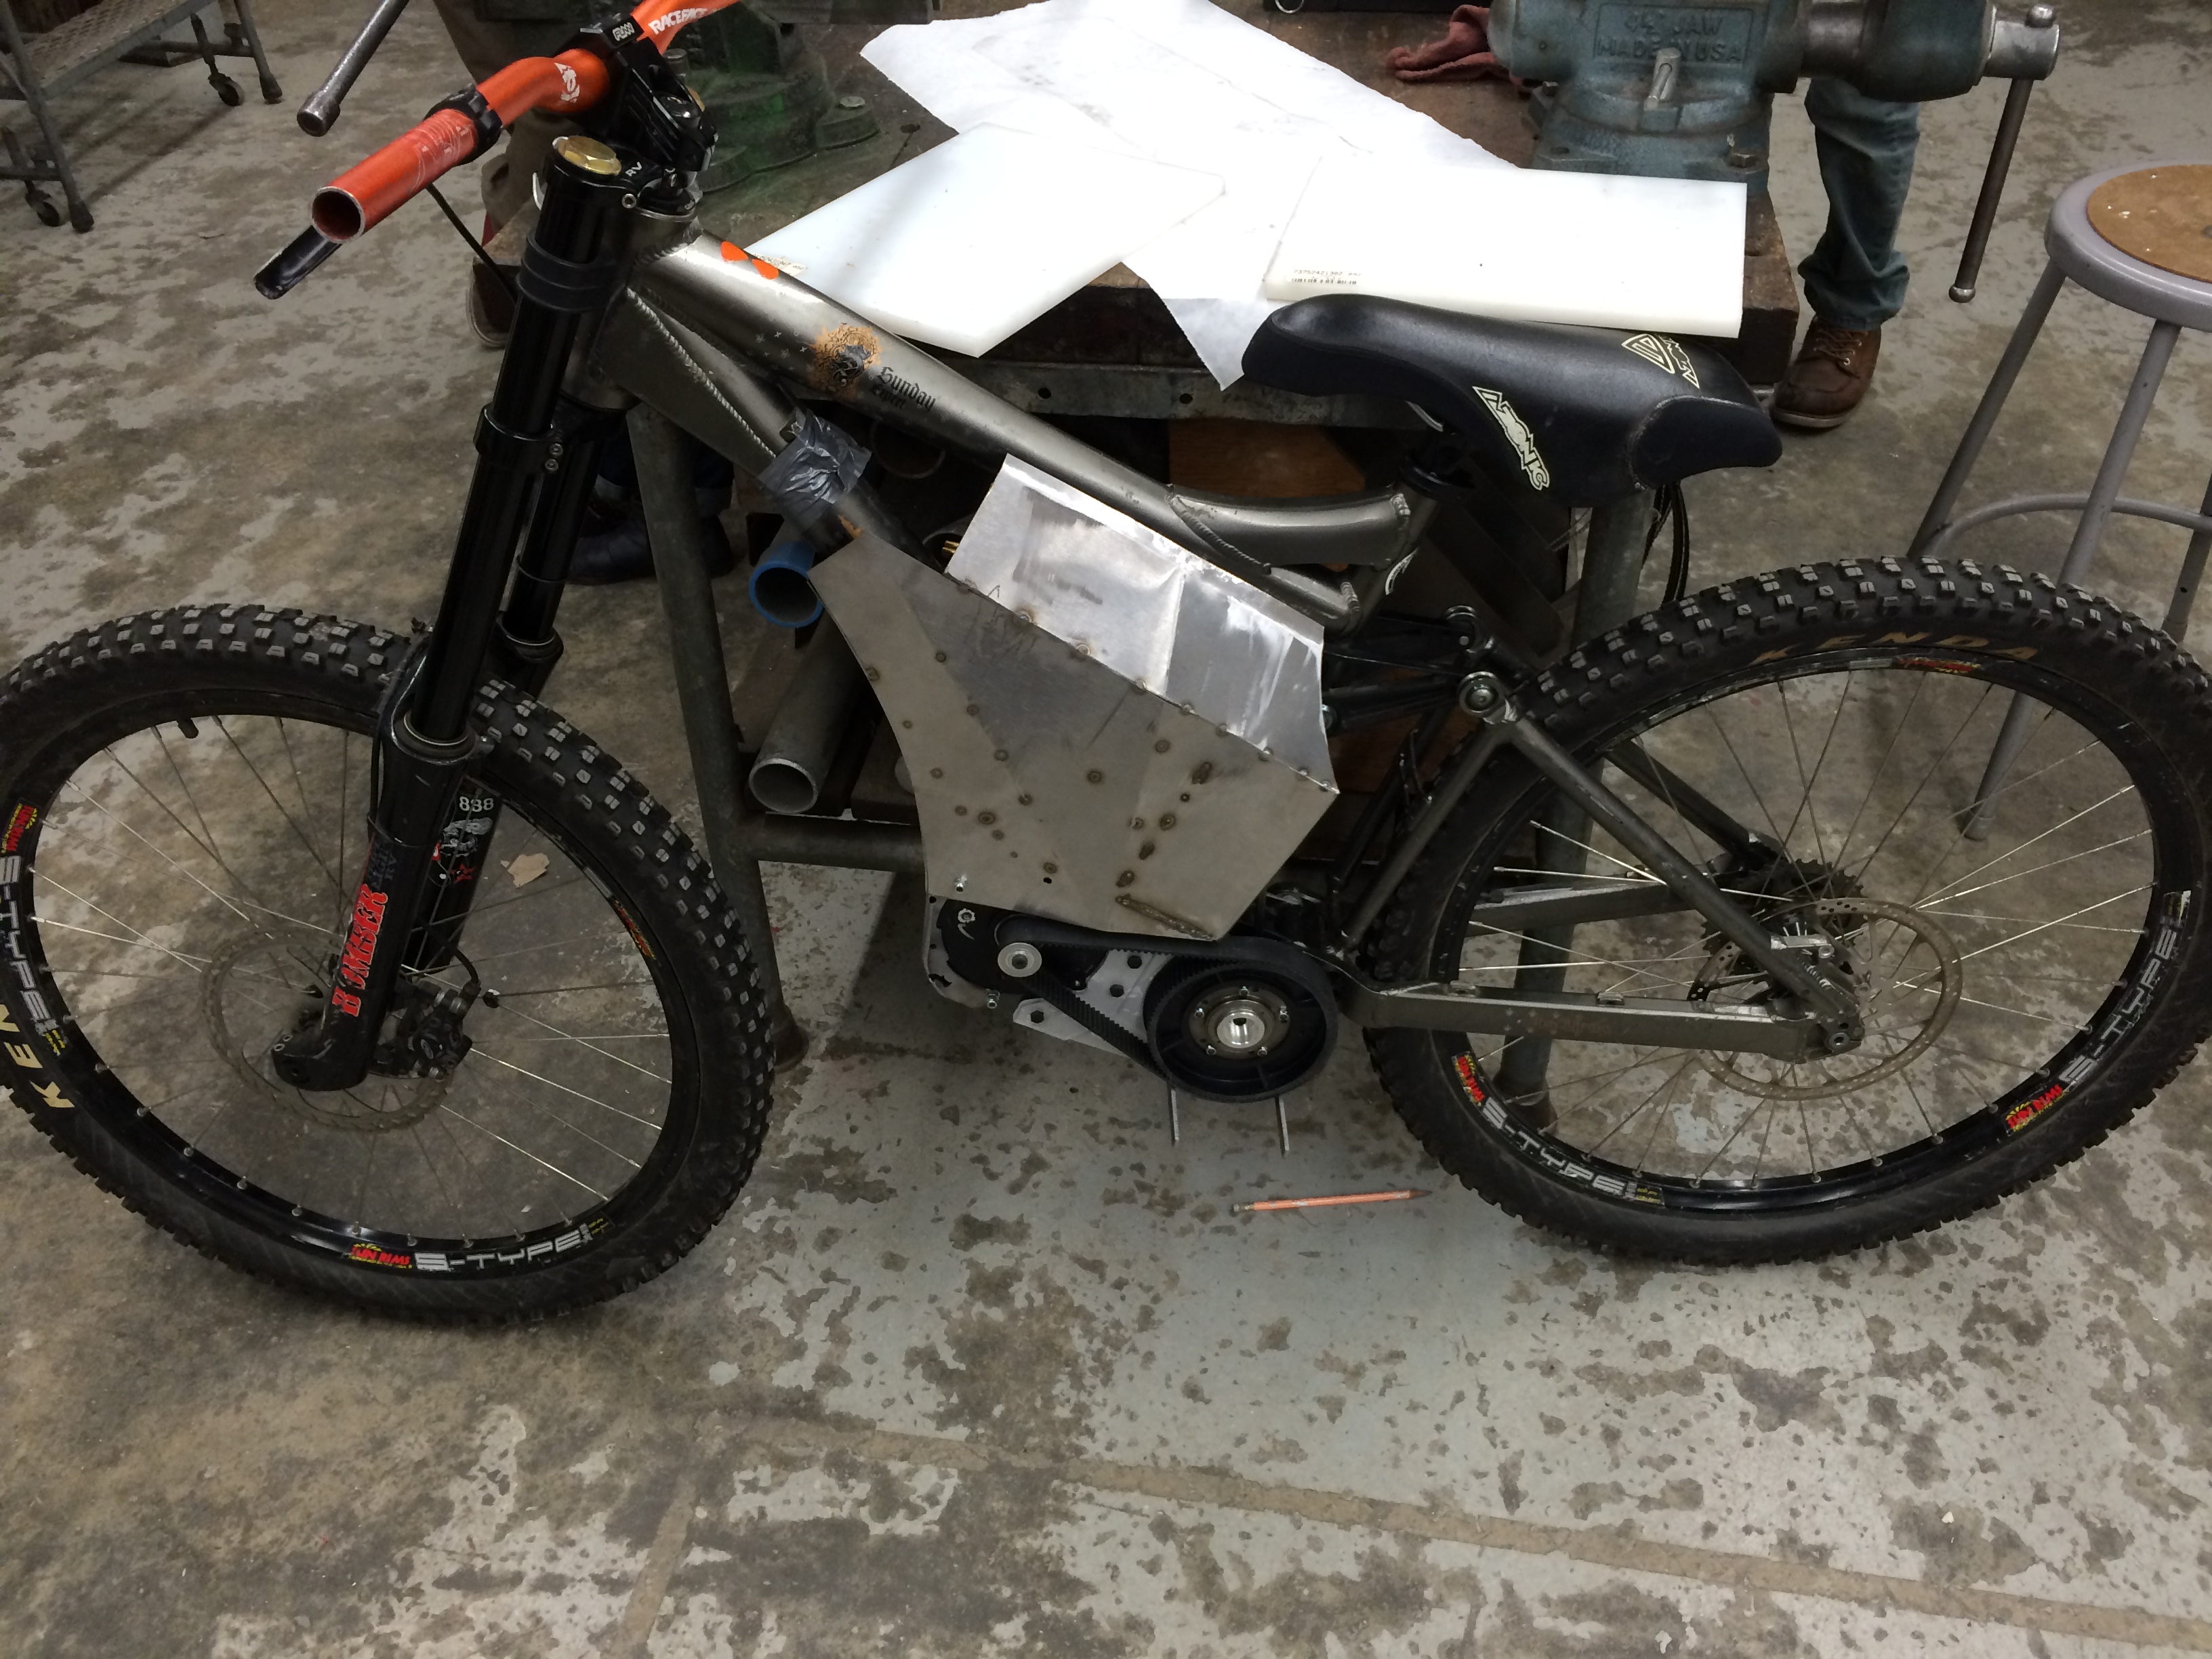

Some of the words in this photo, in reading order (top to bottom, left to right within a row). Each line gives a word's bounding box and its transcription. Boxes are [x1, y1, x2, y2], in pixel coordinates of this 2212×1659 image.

[1696, 41, 1741, 62] USA
[877, 367, 937, 411] Sunday
[459, 796, 494, 812] 888
[331, 883, 388, 1017] BOMBER
[2058, 928, 2177, 1082] S-TYPE
[1482, 1096, 1626, 1195] S-TYPE
[415, 1229, 583, 1271] S-TYPE
